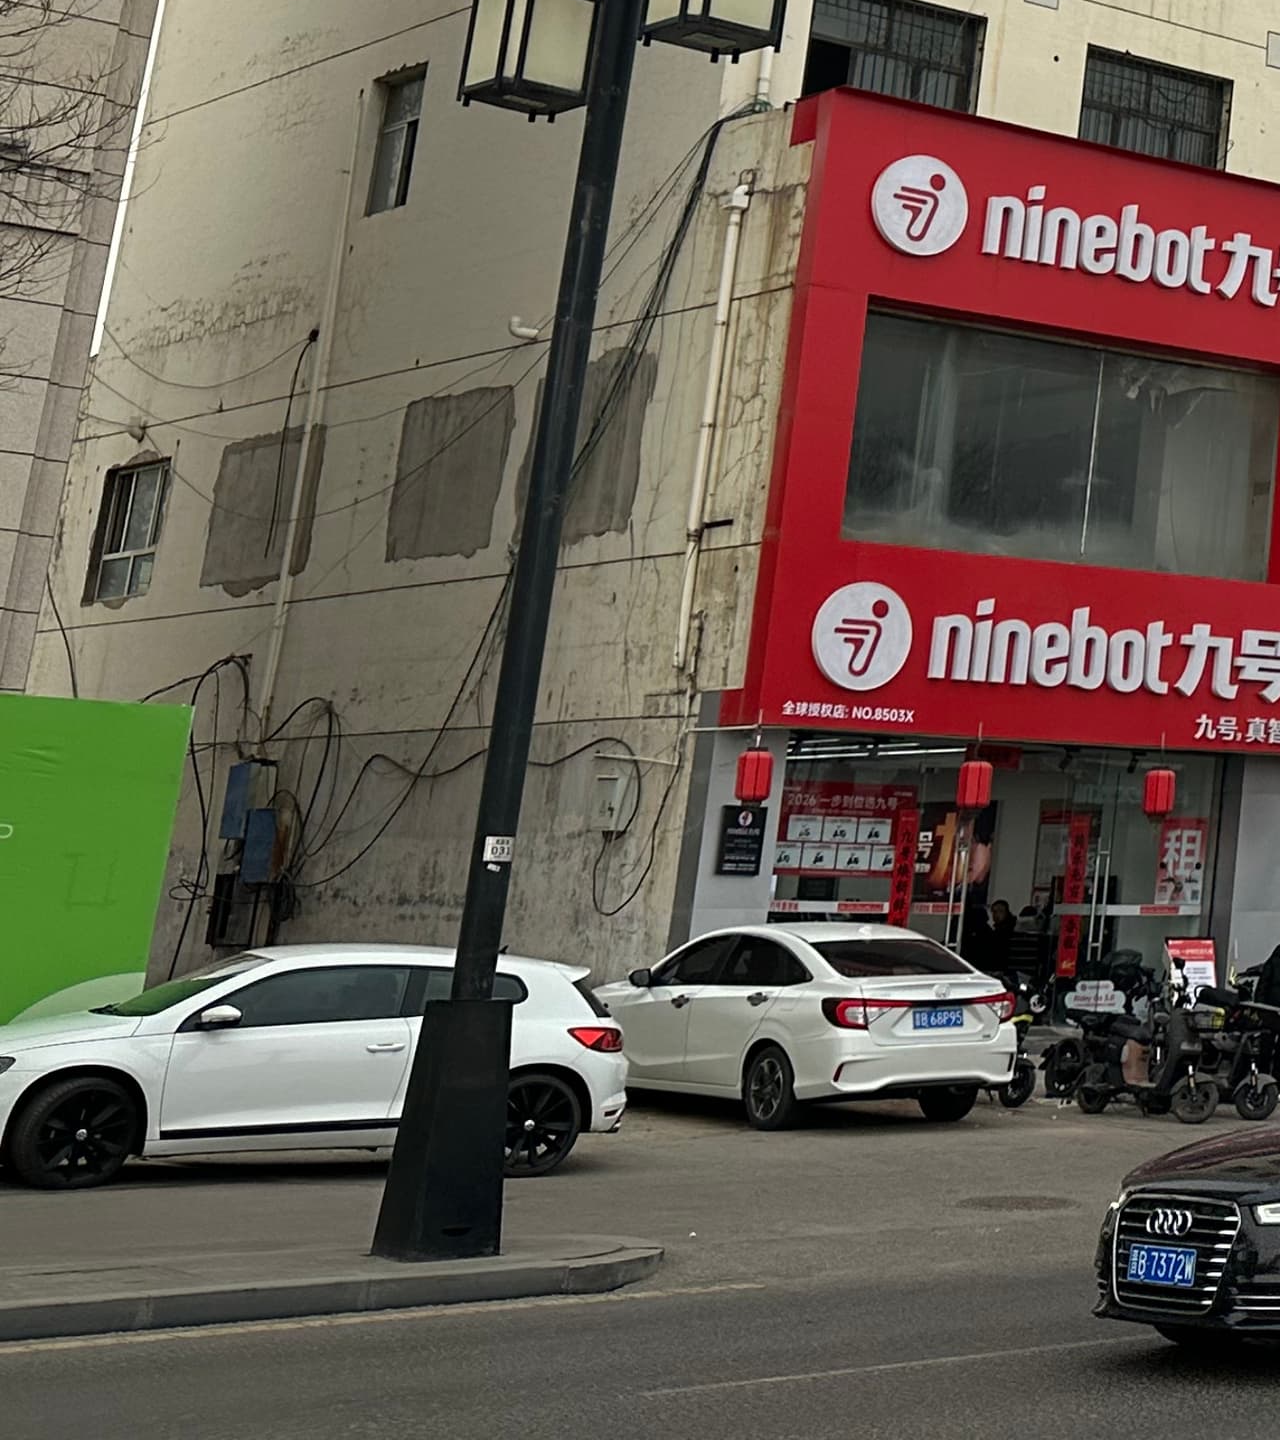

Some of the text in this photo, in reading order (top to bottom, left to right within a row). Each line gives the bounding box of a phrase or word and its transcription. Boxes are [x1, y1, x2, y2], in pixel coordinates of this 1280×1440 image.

[981, 185, 1212, 294] ninebot
[926, 597, 1175, 695] ninebot
[852, 705, 915, 723] NO.8503X
[1164, 828, 1202, 878] 租
